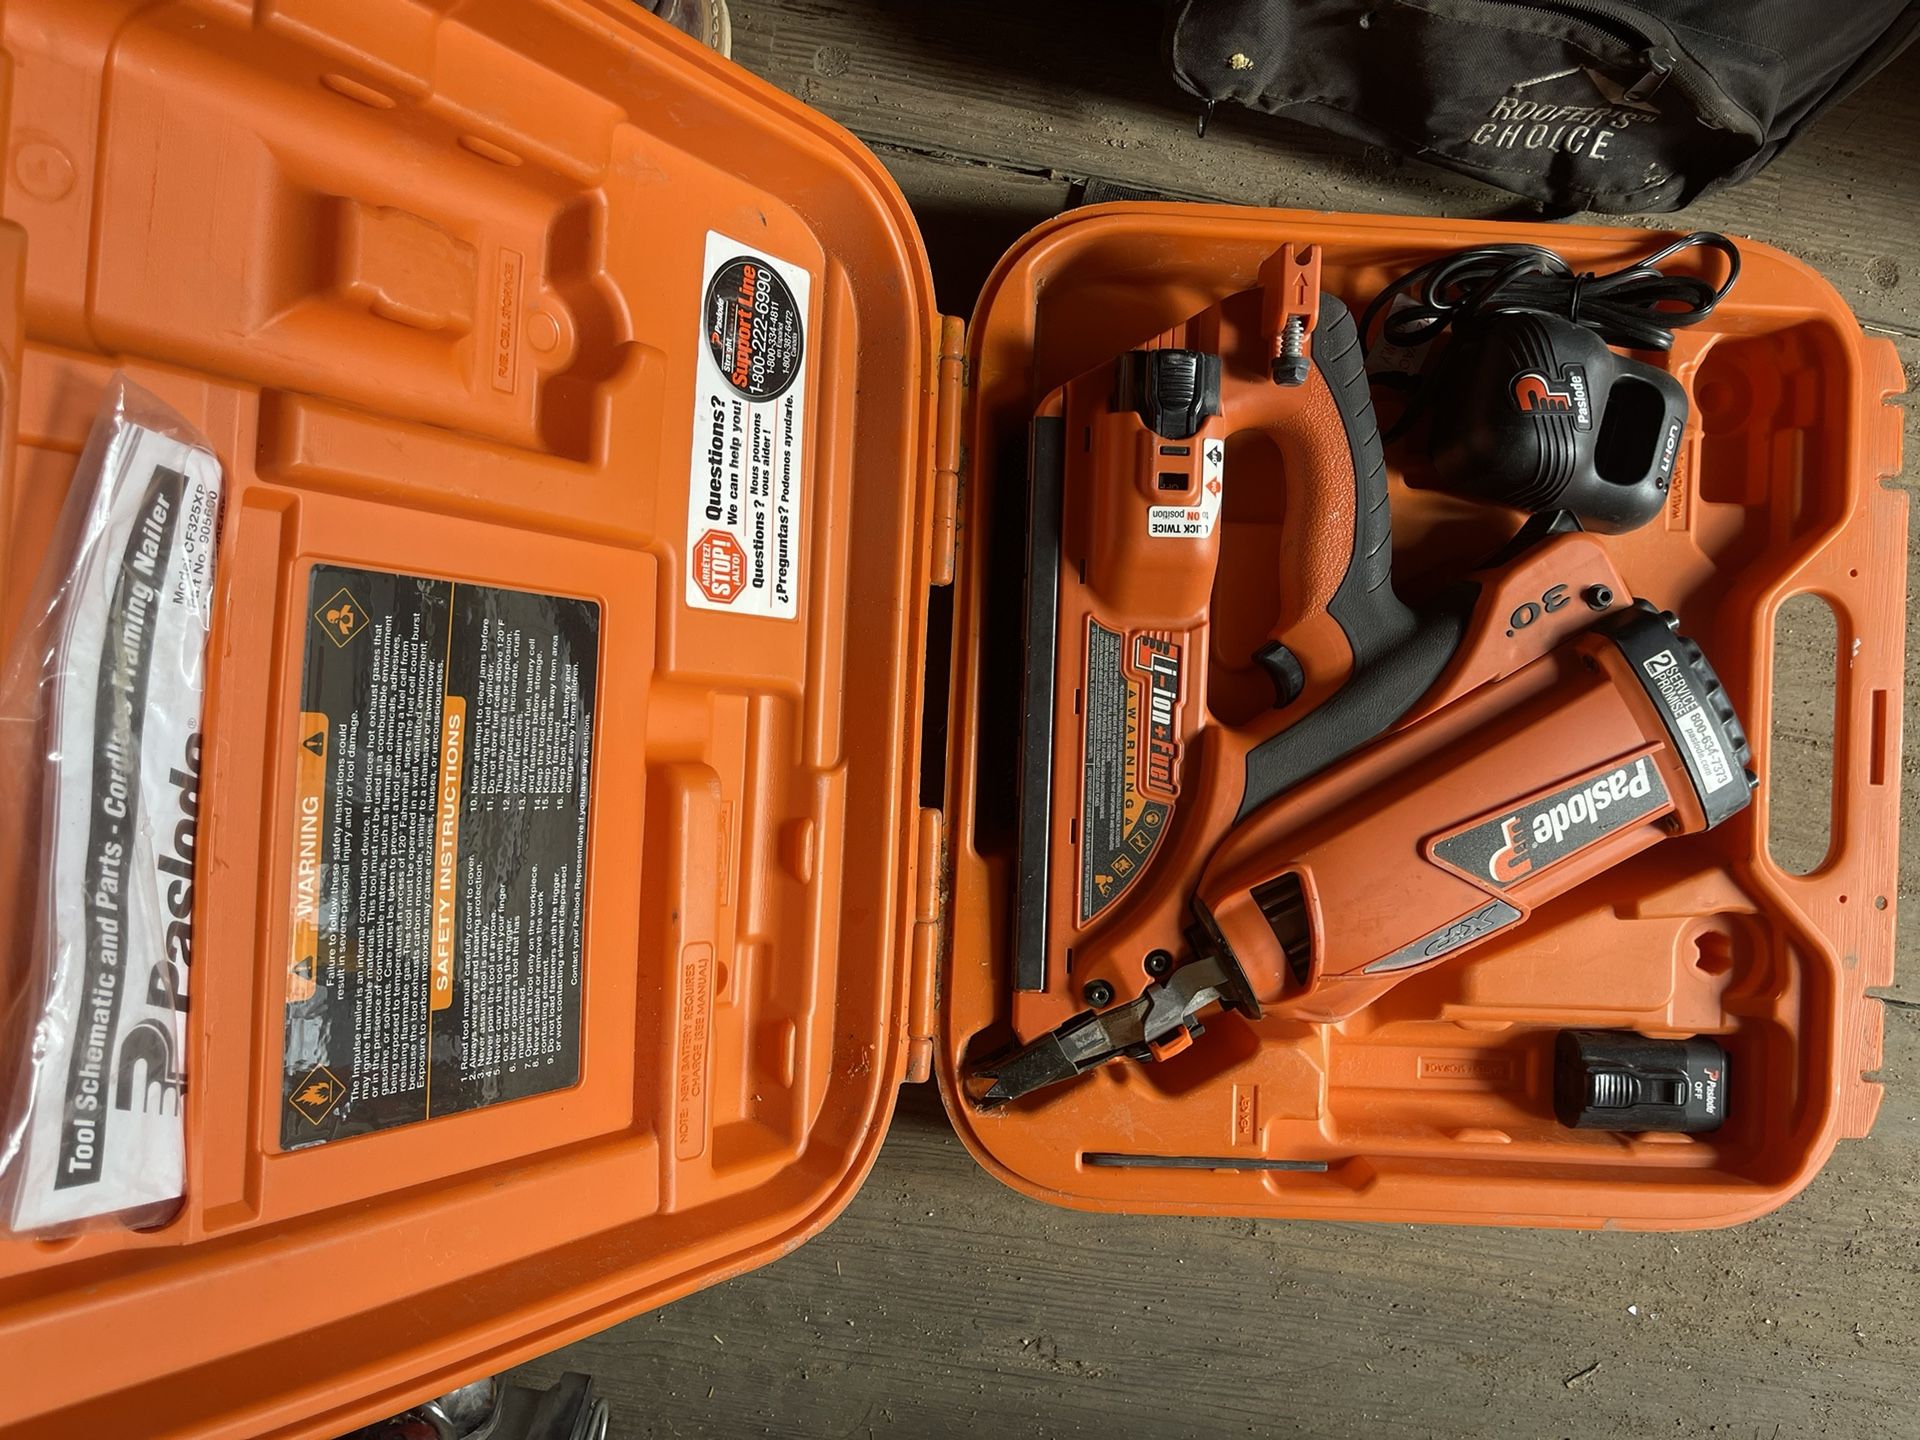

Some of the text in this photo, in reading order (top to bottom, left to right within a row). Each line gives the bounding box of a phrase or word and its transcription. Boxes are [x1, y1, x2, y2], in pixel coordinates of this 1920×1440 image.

[1470, 123, 1614, 160] CHOICE
[715, 298, 724, 334] Paslode
[732, 265, 755, 388] Support Line
[749, 269, 772, 393] 1-800-222-6990
[767, 301, 779, 374] 1-800-334-4811
[776, 349, 782, 358] en
[783, 310, 793, 374] 1-800-387-6472
[1574, 375, 1589, 424] Paslode
[706, 395, 725, 521] Questions?
[727, 400, 742, 525] We can help you!
[750, 413, 761, 495] Nous pouvons
[762, 436, 771, 466] aider
[183, 484, 206, 554] CF325XP
[777, 395, 794, 603] ¿Preguntas? Podemos ayudarle.
[1152, 509, 1185, 521] position
[1186, 511, 1200, 521] ON
[133, 494, 171, 577] Nailer
[1152, 523, 1181, 535] TWICE
[194, 549, 208, 575] No.
[701, 543, 711, 586] ARRÊTEZ!
[712, 540, 730, 595] STOP!
[732, 553, 740, 585] ¡ALTO!
[752, 512, 764, 588] Questions
[111, 581, 153, 693] Framing
[373, 623, 383, 646] that
[372, 647, 383, 682] gases
[494, 650, 503, 682] above
[1650, 654, 1672, 673] 2
[367, 683, 379, 728] exhaust
[492, 683, 501, 708] cells
[1654, 674, 1687, 719] PROMISE
[1665, 666, 1699, 712] SERVICE
[337, 723, 347, 755] could
[346, 709, 360, 758] damage.
[366, 729, 376, 748] hot
[491, 709, 500, 729] fuel
[581, 712, 592, 757] questions.
[489, 730, 499, 757] store
[534, 696, 548, 810] 14. Keep the tool clean.
[1126, 706, 1137, 809] WARNING
[1685, 728, 1713, 776] paslode.com
[1690, 712, 1728, 784] 800-634-7373
[345, 760, 355, 782] tool
[363, 750, 377, 805] produces
[488, 759, 497, 777] not
[581, 756, 590, 776] any
[333, 757, 346, 824] instructions
[486, 796, 495, 811] 11.
[579, 774, 587, 799] have
[1532, 759, 1651, 843] Paslode
[343, 806, 353, 829] and
[579, 797, 588, 817] you
[296, 795, 319, 915] WARNING
[331, 825, 344, 860] safety
[341, 830, 354, 862] injury
[360, 815, 371, 856] device.
[435, 713, 460, 992] SAFETY INSTRUCTIONS
[467, 853, 475, 886] cover.
[574, 822, 586, 890] Representative
[95, 842, 123, 911] Parts
[330, 862, 341, 894] these
[339, 863, 352, 913] personal
[357, 857, 369, 924] combustion
[473, 860, 485, 917] protection.
[328, 893, 339, 933] follow
[465, 900, 473, 931] cover
[572, 890, 581, 927] Paslode
[96, 917, 119, 966] and
[338, 914, 348, 953] severe
[355, 925, 366, 968] internal
[472, 917, 483, 958] hearing
[572, 928, 581, 949] your
[325, 947, 336, 987] Failure
[463, 931, 474, 977] carefully
[471, 959, 480, 980] and
[569, 949, 578, 986] Contact
[334, 967, 345, 1001] result
[461, 978, 471, 1018] manual
[472, 980, 481, 1001] eye
[696, 958, 708, 1015] MANUAL)
[352, 998, 362, 1031] nailer
[460, 1018, 469, 1040] tool
[471, 1002, 479, 1029] wear
[76, 974, 116, 1111] Schematic
[350, 1031, 363, 1078] Impulse
[459, 1041, 469, 1071] Read
[468, 1029, 479, 1069] Always
[679, 963, 695, 1144] NOTE: NEW BATTERY REQUIRES
[691, 1044, 702, 1097] CHARGE
[1694, 1081, 1704, 1100] OFF
[350, 1079, 359, 1103] The
[1706, 1080, 1717, 1113] Paslode
[68, 1120, 95, 1173] Tool
